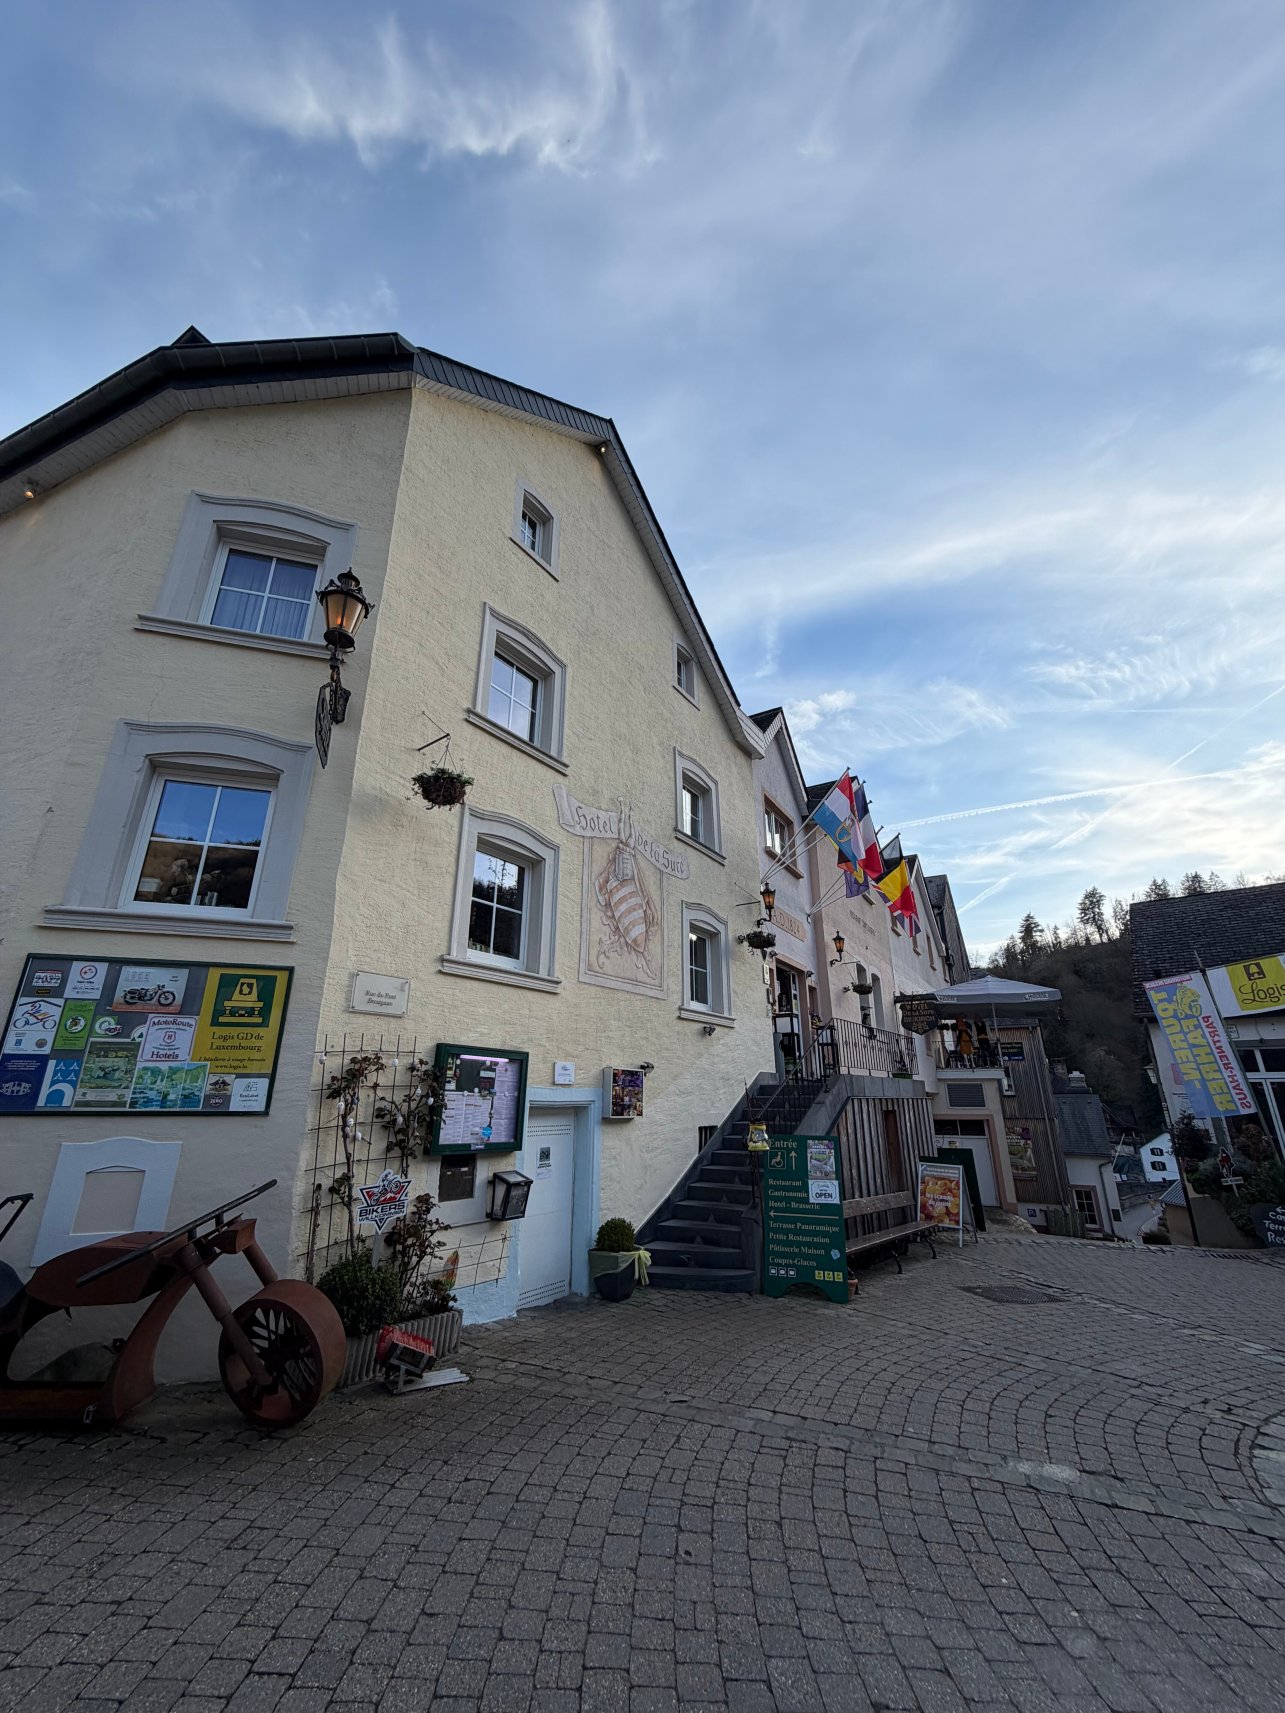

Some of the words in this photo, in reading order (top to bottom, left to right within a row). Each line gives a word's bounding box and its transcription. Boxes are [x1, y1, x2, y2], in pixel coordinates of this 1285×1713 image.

[575, 805, 614, 834] Hotel
[637, 830, 649, 852] De
[650, 842, 660, 864] la
[151, 1019, 194, 1029] MotoRoute
[211, 1031, 235, 1042] Logis
[236, 1032, 254, 1041] GD
[254, 1032, 264, 1041] de
[209, 1042, 262, 1053] Luxembourg
[150, 1050, 180, 1060] Hotels
[769, 1138, 798, 1149] Entrée
[768, 1178, 803, 1188] Restaurant
[815, 1192, 833, 1200] OPEN
[359, 1201, 406, 1217] BIKERS
[768, 1200, 786, 1209] Hotel
[791, 1201, 821, 1210] Brasserie
[359, 1210, 405, 1222] WILLKOMMEN
[769, 1220, 796, 1230] Terrasse
[796, 1222, 840, 1233] Panoramique
[769, 1232, 788, 1241] Petite
[789, 1233, 830, 1244] Restauration
[769, 1243, 799, 1253] Pâtisserie
[800, 1245, 825, 1255] Maison
[769, 1255, 817, 1267] Coupes-Glaces
